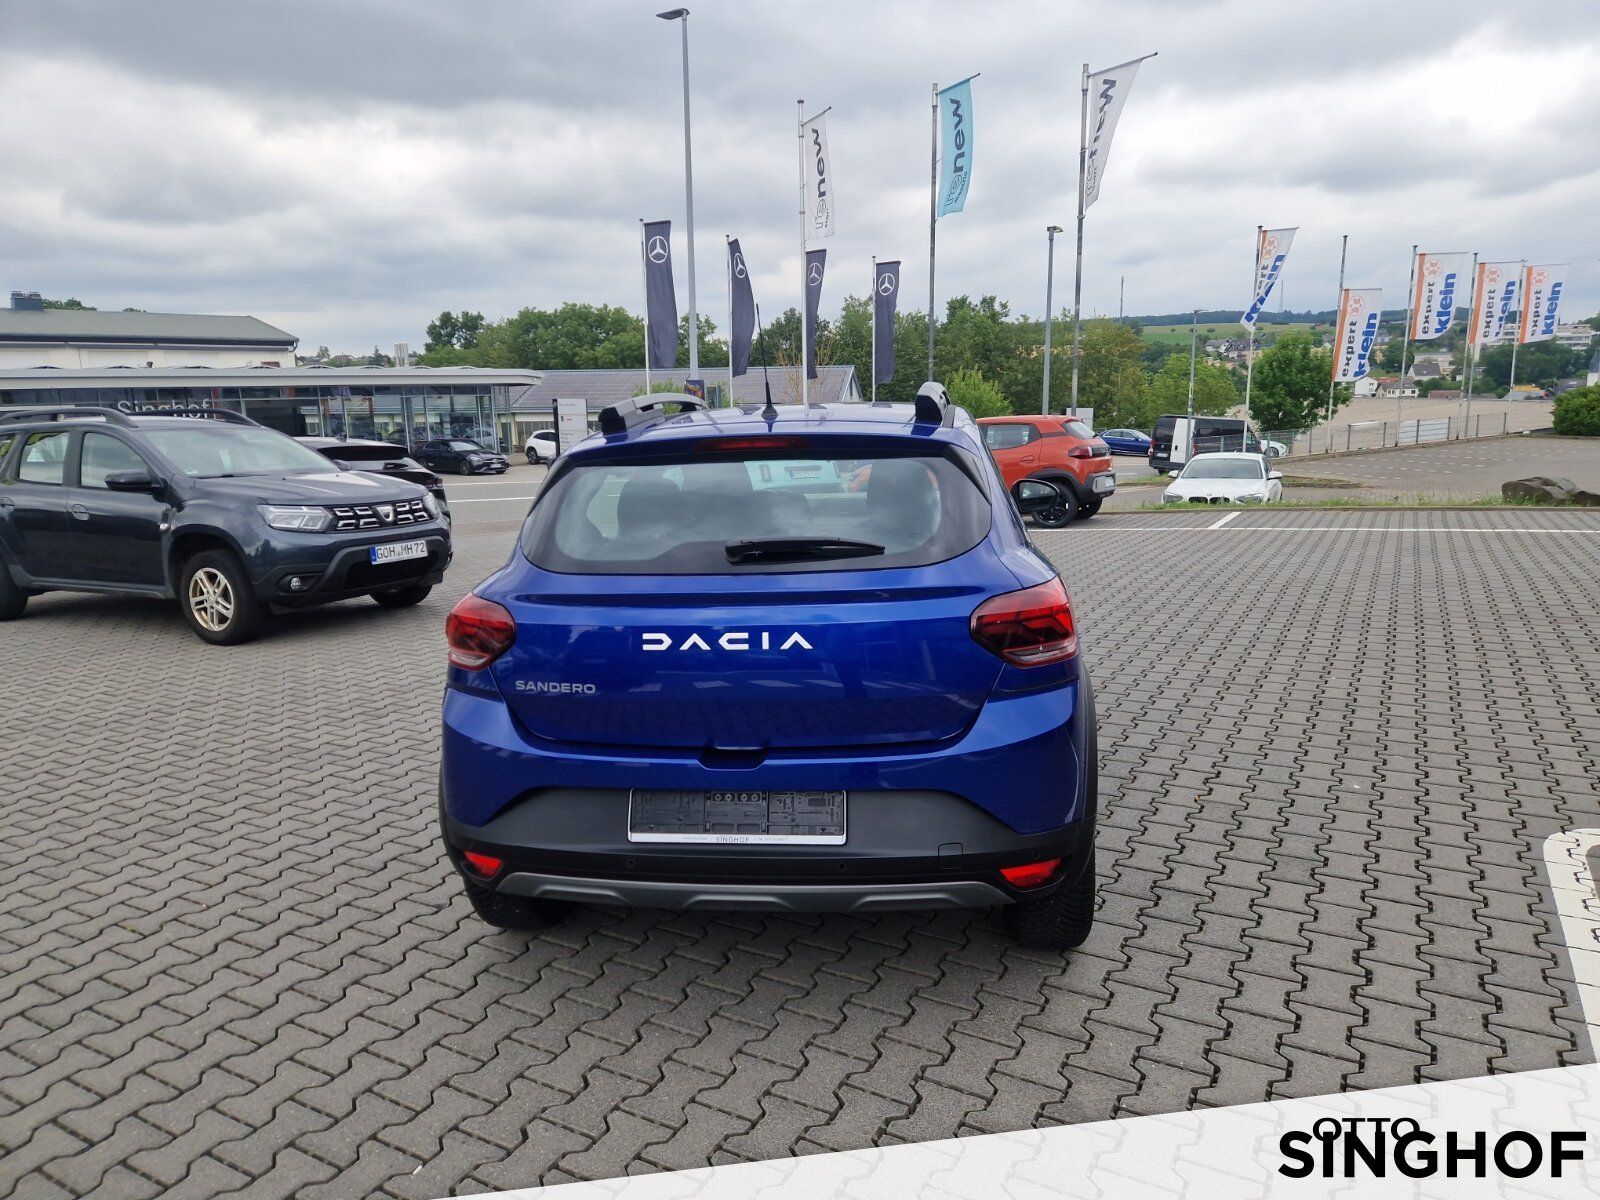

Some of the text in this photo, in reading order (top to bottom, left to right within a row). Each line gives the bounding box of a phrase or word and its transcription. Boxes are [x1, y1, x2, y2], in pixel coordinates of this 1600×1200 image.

[811, 127, 827, 230] renew
[944, 97, 966, 207] renew
[1421, 281, 1435, 335] expert
[1434, 272, 1457, 334] klein
[1482, 288, 1496, 339] expert
[1530, 288, 1542, 337] expert
[1541, 281, 1563, 335] klein
[1341, 320, 1358, 378] expert
[1352, 312, 1378, 378] klein
[376, 546, 395, 559] GOH
[641, 631, 814, 651] DACIA
[514, 680, 596, 694] SANDERO
[715, 836, 750, 844] SINGHOF
